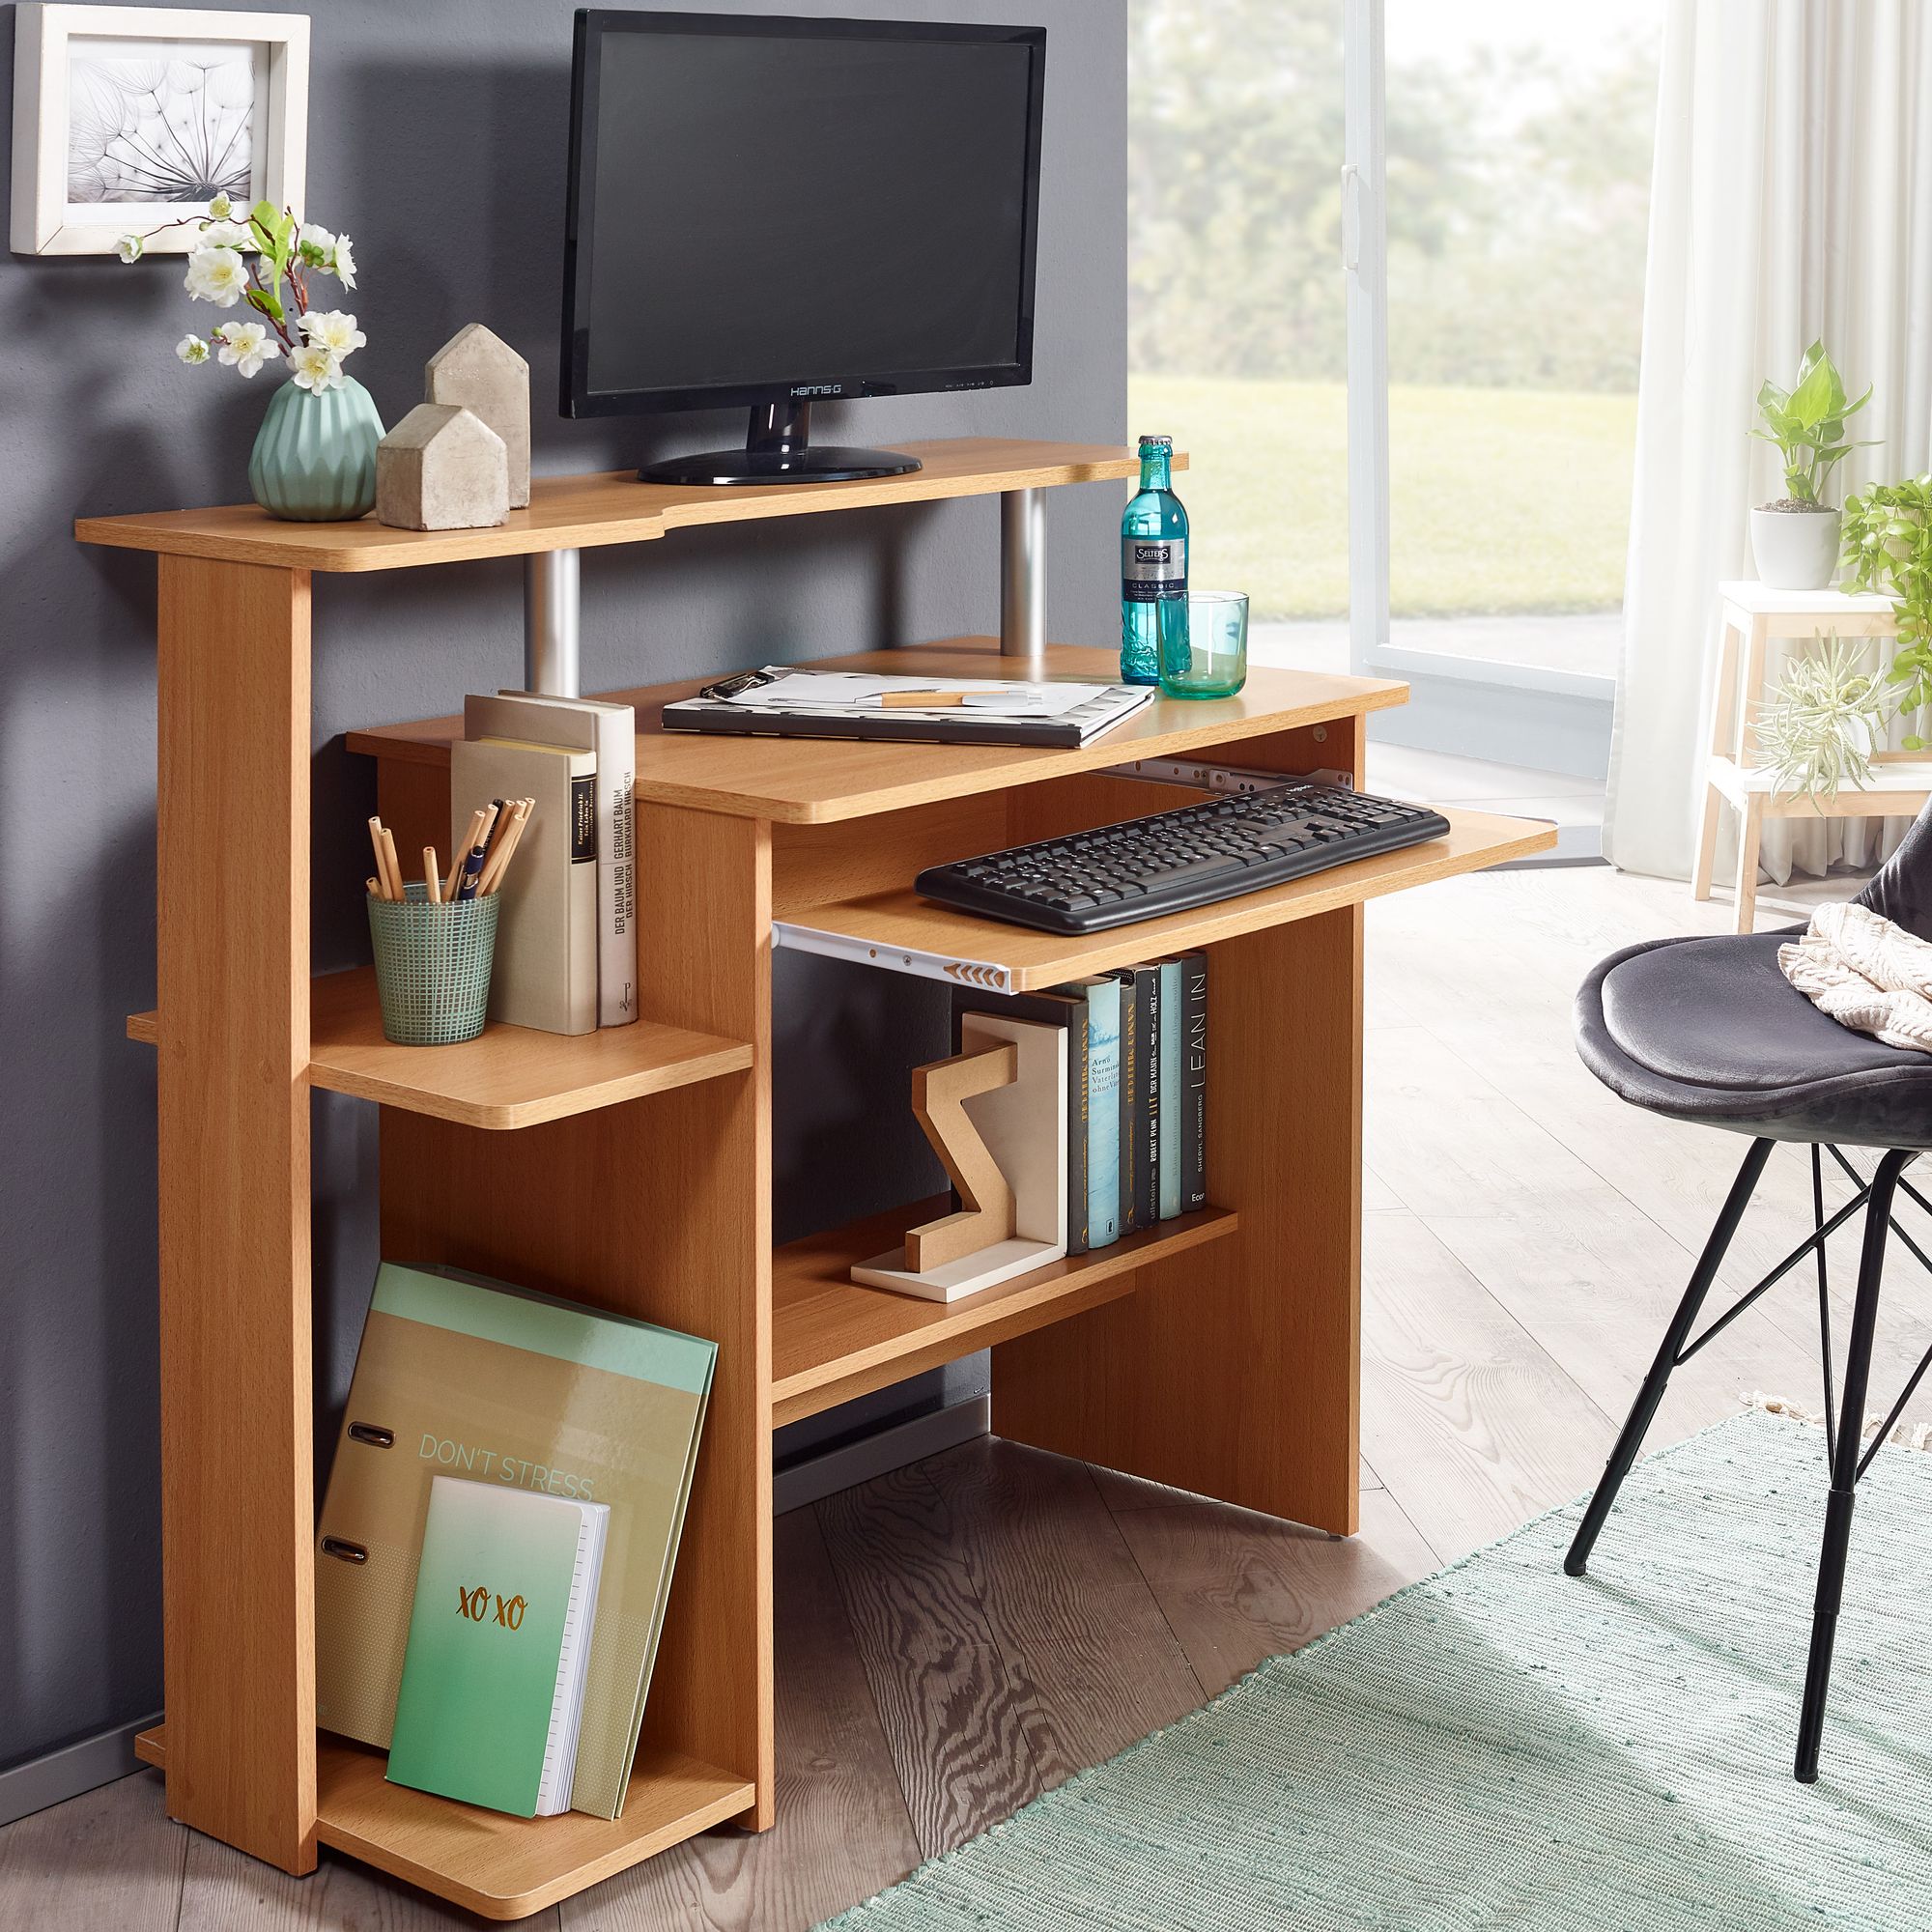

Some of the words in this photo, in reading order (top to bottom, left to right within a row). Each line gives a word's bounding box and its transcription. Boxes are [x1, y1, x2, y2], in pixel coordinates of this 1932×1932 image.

[613, 789, 623, 816] BAUM
[613, 819, 624, 859] GERHART
[614, 866, 624, 886] UND
[614, 888, 625, 915] BAUM
[614, 916, 625, 935] DER
[1190, 973, 1206, 1002] IN
[1092, 1058, 1111, 1066] Arno
[1190, 1012, 1207, 1088] LEAN
[418, 1434, 497, 1475] DON'T
[498, 1457, 596, 1502] STRESS
